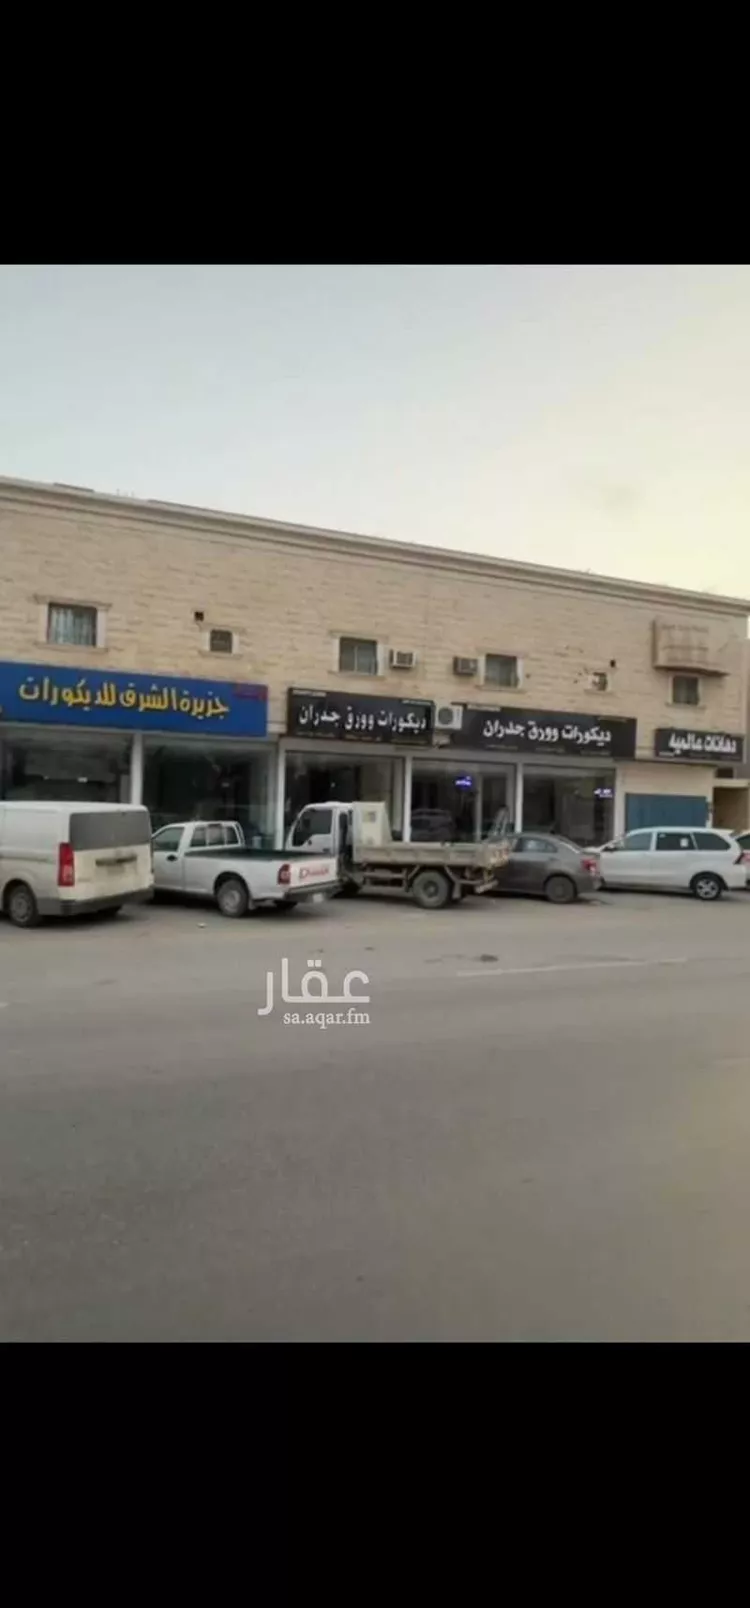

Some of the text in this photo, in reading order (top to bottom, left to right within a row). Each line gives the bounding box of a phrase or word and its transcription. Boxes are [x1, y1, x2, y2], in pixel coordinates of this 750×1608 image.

[180, 689, 229, 720] جزيرة
[299, 704, 427, 734] ديكورات وورق جدران
[483, 718, 612, 746] ديكورات وورق جدران
